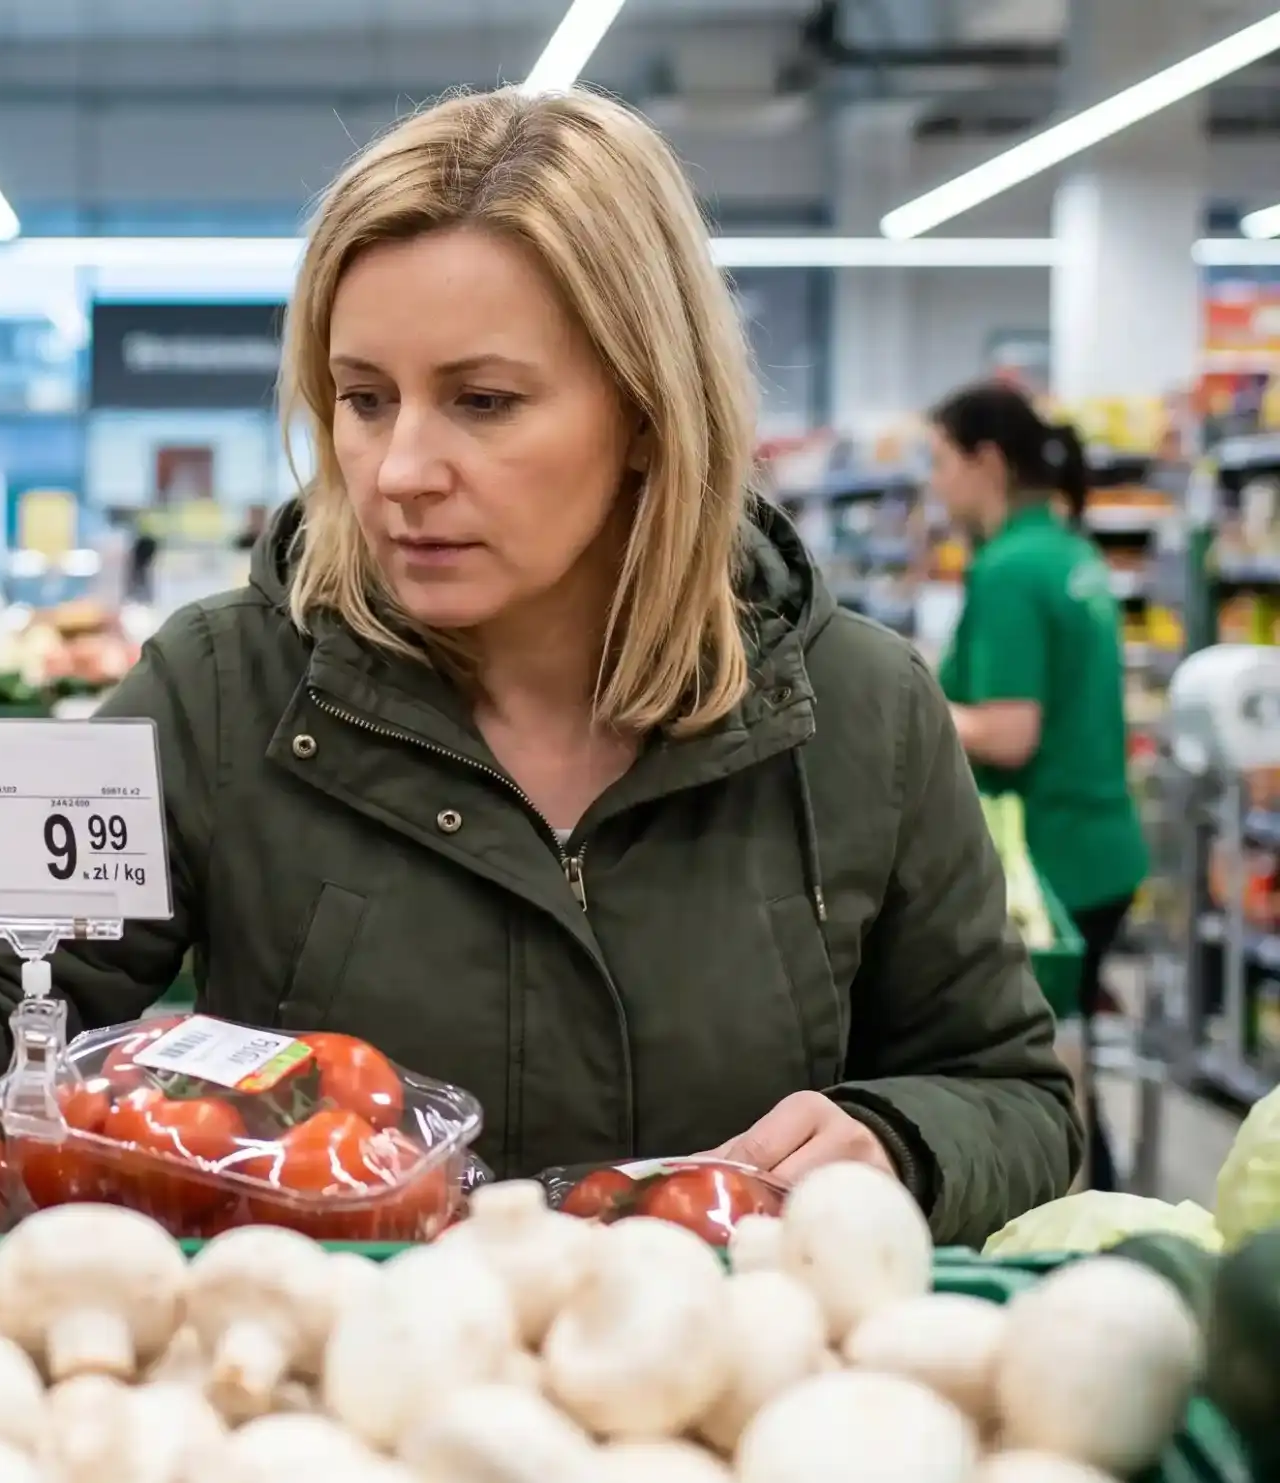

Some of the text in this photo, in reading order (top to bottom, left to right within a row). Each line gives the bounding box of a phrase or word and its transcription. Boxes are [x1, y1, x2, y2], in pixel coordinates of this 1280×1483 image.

[44, 813, 128, 880] 9 99
[124, 863, 145, 886] kg
